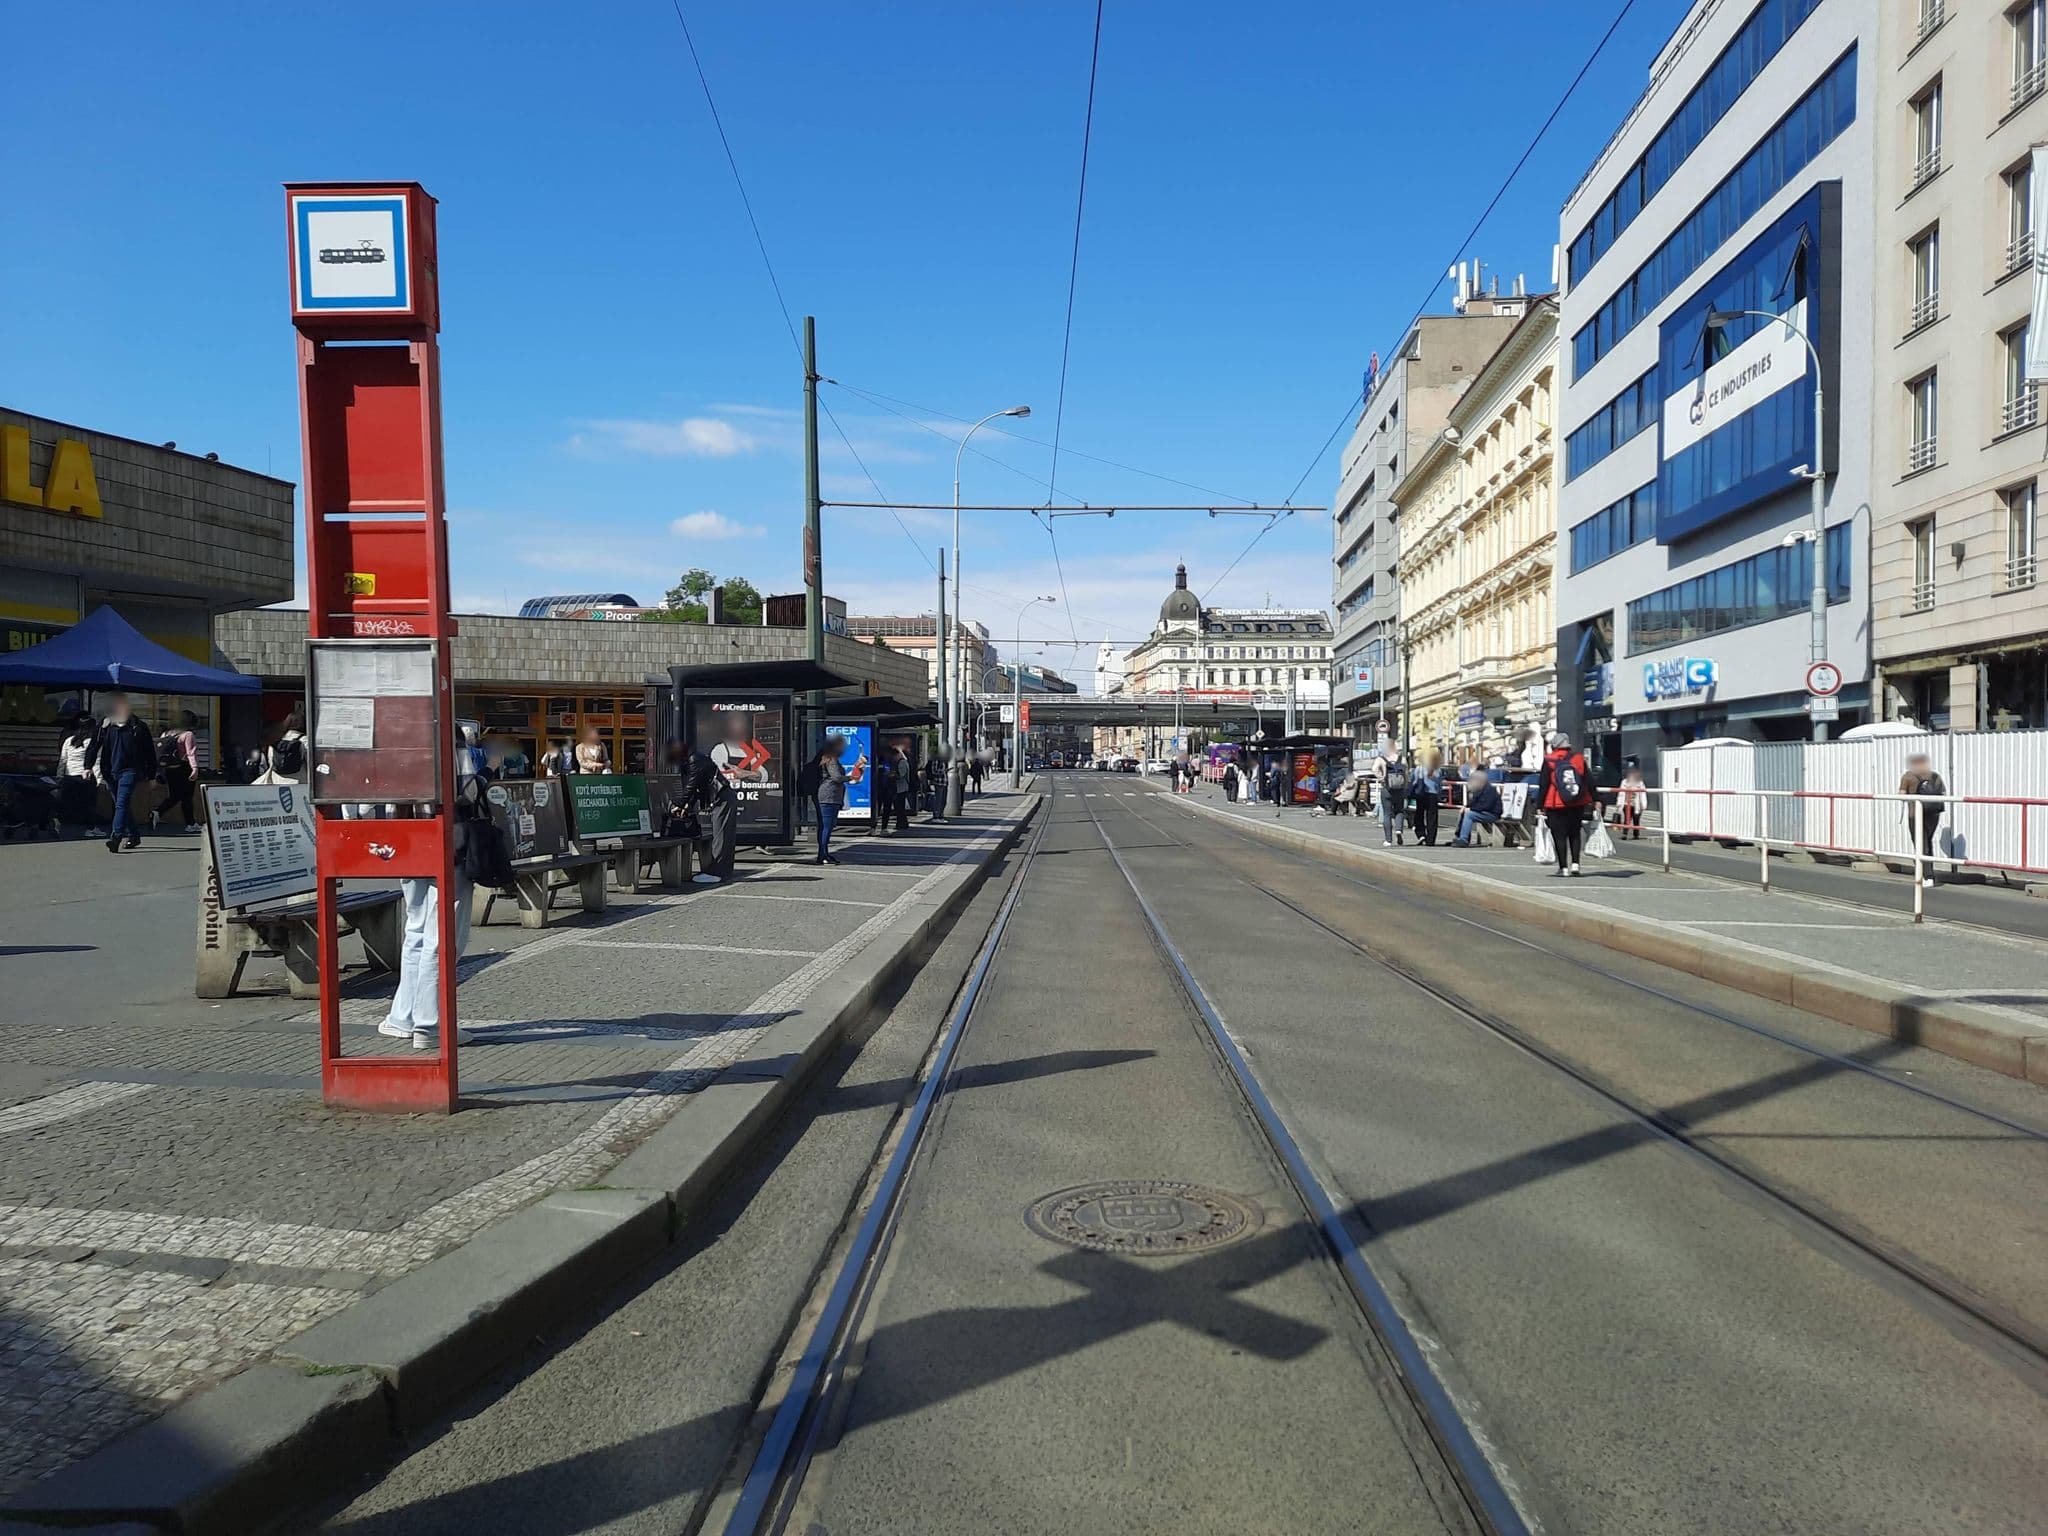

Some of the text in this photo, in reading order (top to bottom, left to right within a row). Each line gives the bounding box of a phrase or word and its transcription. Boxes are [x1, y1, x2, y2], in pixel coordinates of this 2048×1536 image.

[1709, 353, 1772, 408] CE INDUSTRIES
[746, 790, 760, 801] Kč
